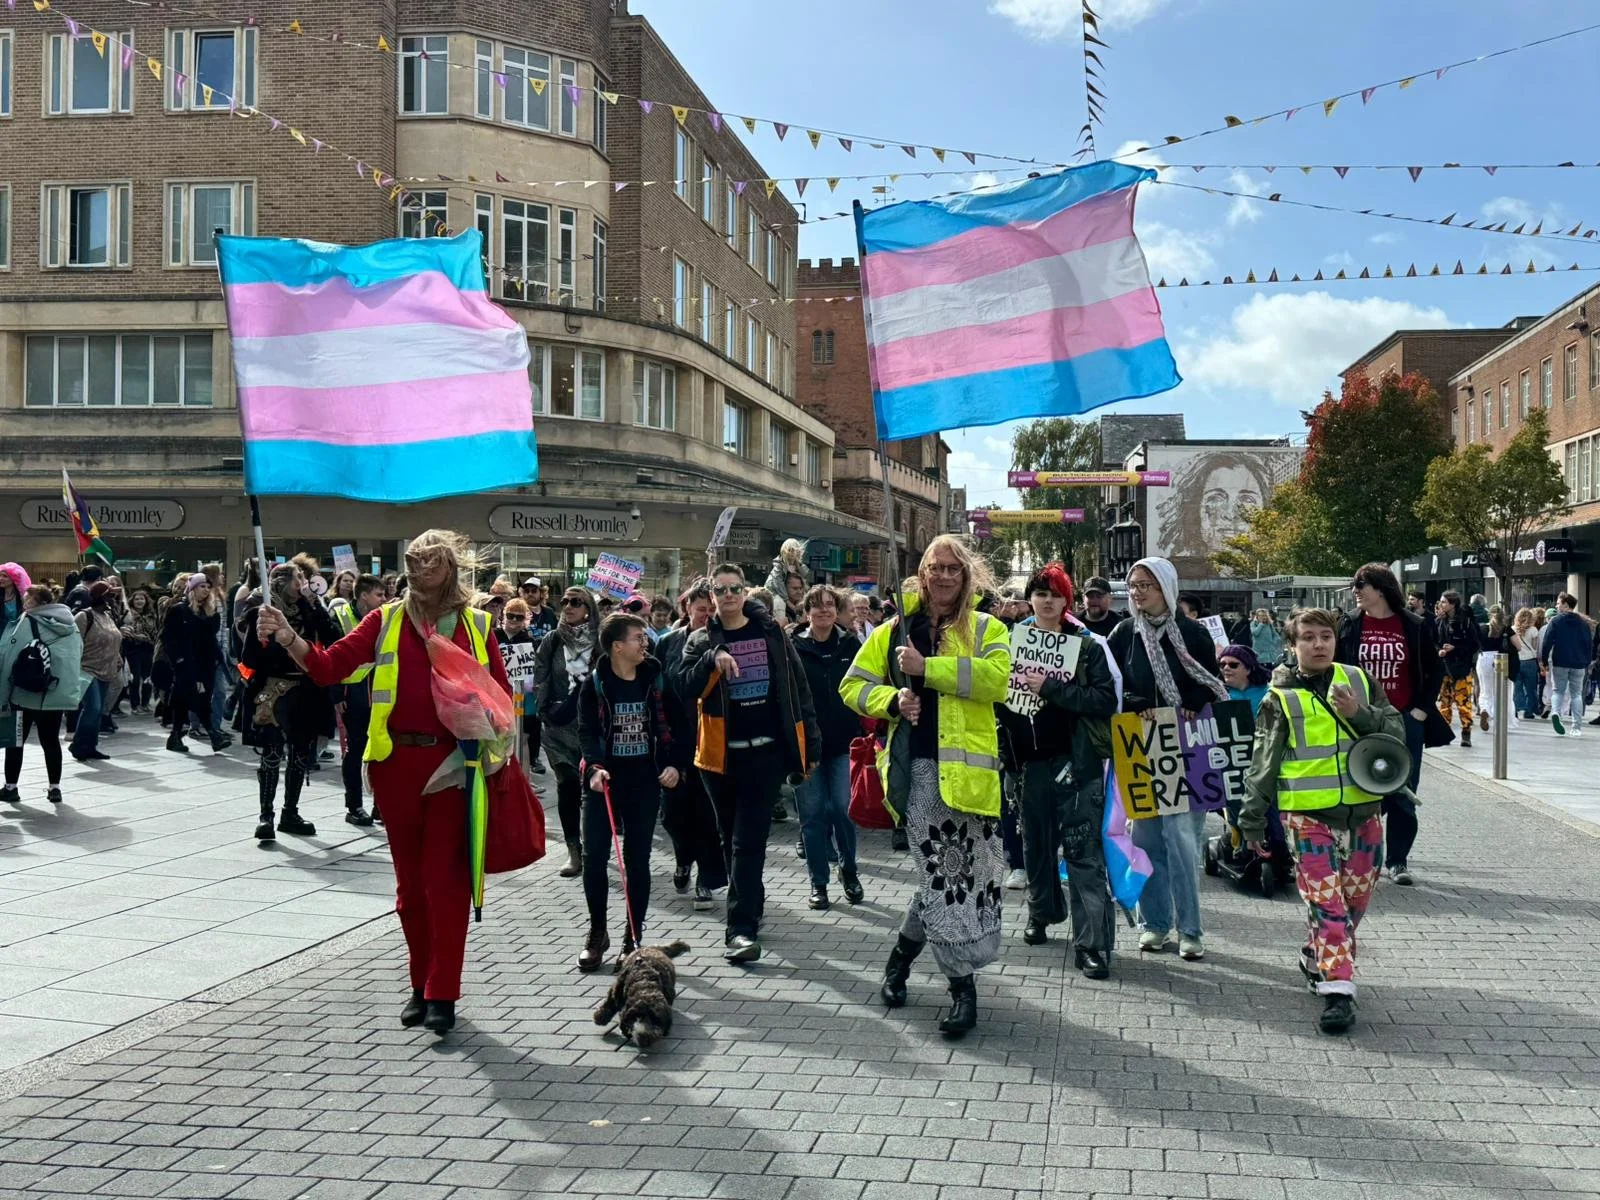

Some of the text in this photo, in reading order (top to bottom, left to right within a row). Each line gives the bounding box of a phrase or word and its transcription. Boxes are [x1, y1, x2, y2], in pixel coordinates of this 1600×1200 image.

[100, 505, 165, 527] Bromley
[512, 512, 567, 530] Russell
[575, 514, 629, 537] Bromley
[622, 575, 634, 585] THE
[1026, 628, 1068, 652] STOP
[1359, 642, 1405, 661] RANS
[1364, 660, 1403, 680] RIDE
[1008, 677, 1030, 692] abo
[615, 703, 648, 714] TRANS
[1005, 690, 1048, 709] WITHO
[1117, 716, 1253, 758] WE WILL
[1132, 744, 1251, 779] NOT BE
[1127, 770, 1244, 812] ERASE
